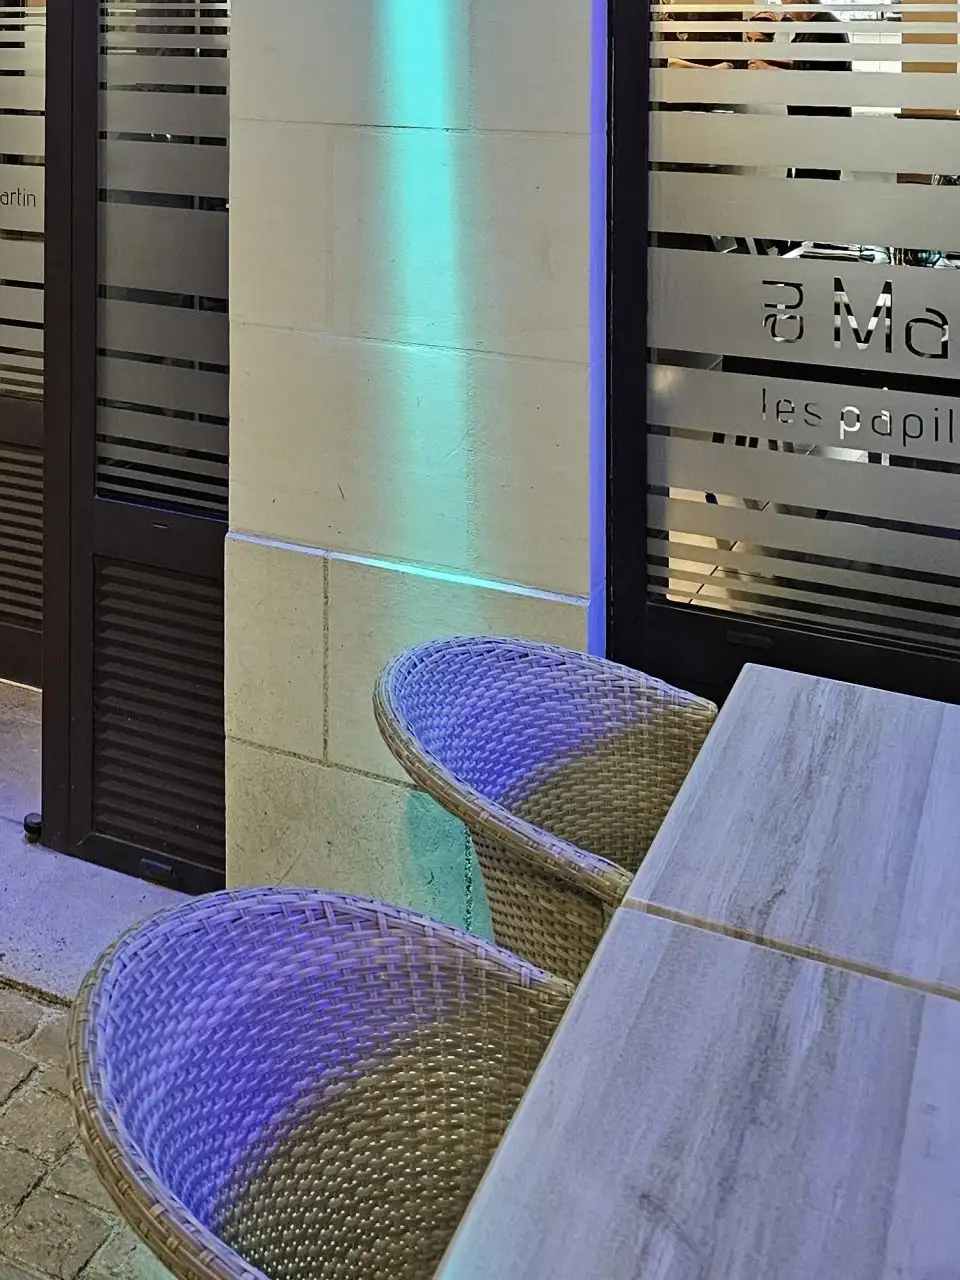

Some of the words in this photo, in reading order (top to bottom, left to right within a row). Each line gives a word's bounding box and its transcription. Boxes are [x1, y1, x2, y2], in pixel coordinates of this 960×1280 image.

[833, 275, 949, 360] Ma
[762, 387, 822, 427] les
[839, 404, 954, 447] papil
